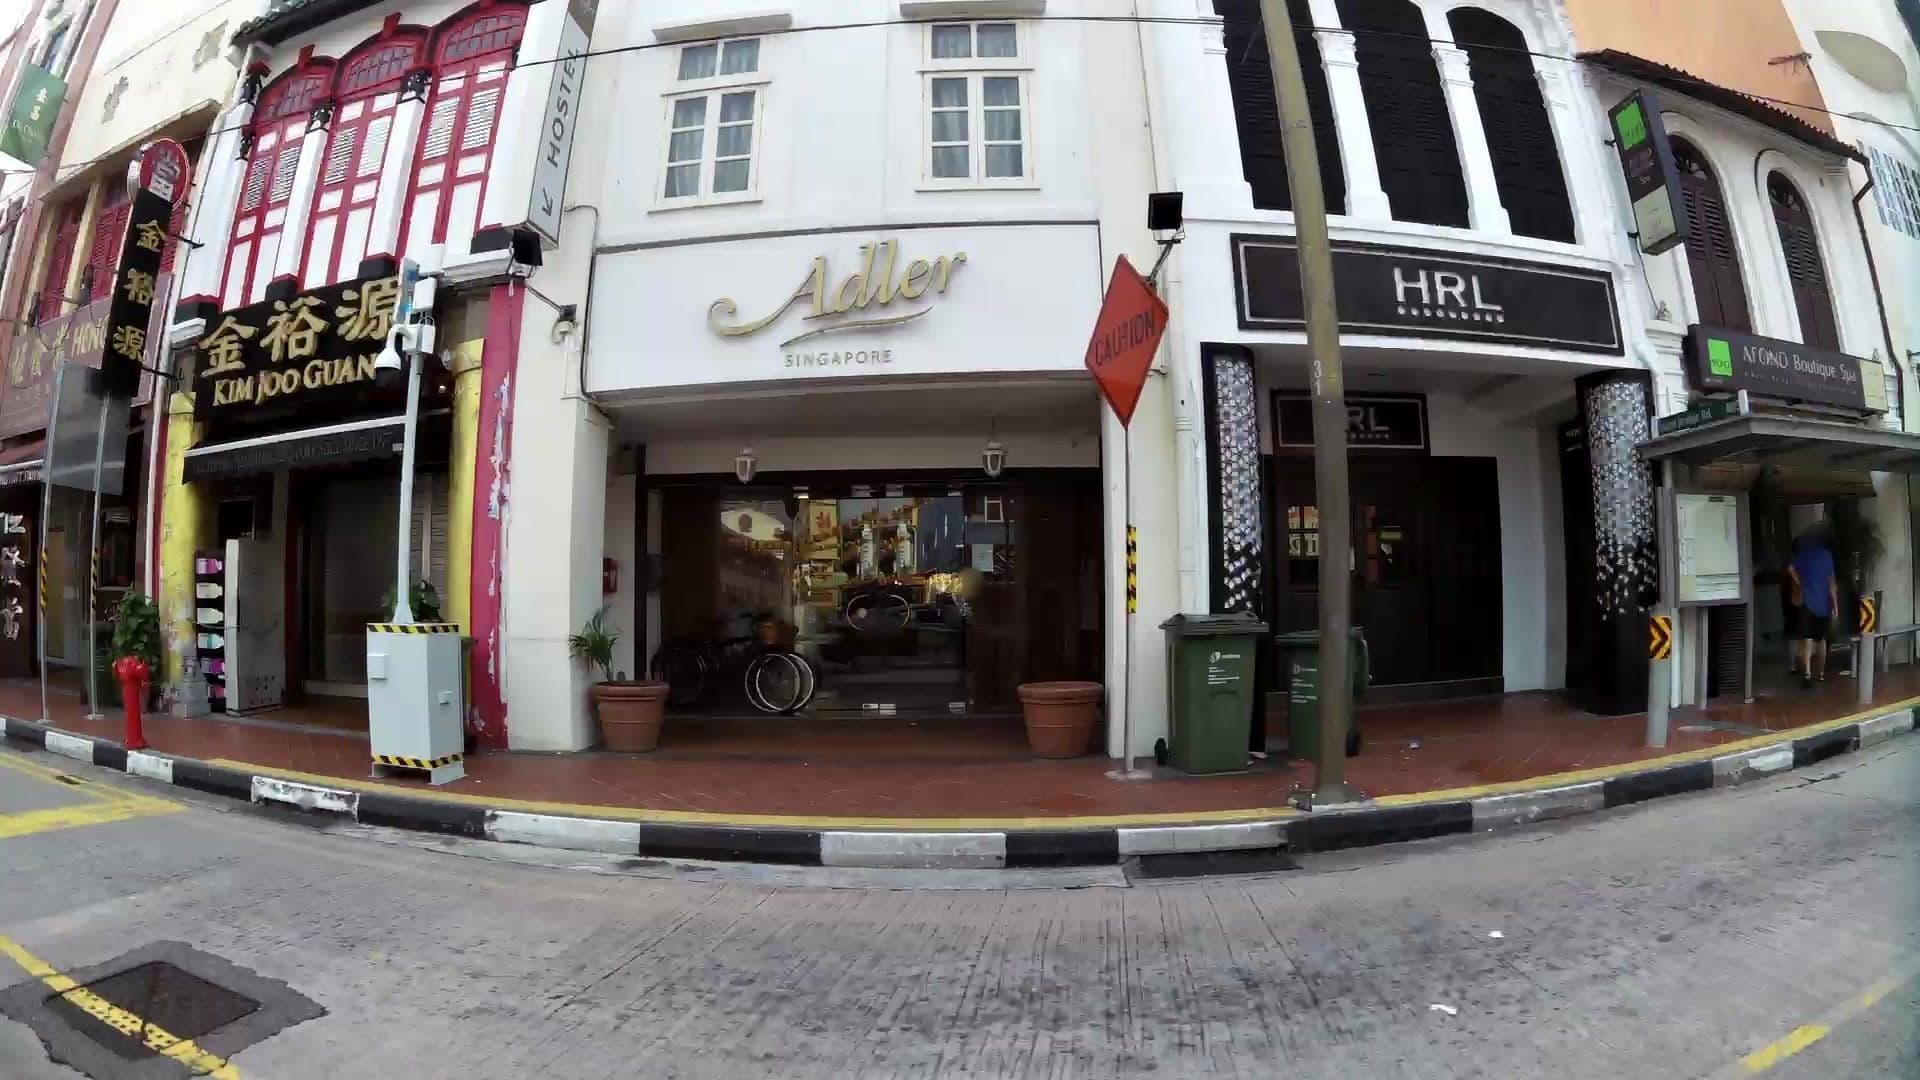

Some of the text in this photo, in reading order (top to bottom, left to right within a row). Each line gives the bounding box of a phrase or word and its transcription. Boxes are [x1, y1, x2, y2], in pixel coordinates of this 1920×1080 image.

[547, 48, 579, 168] HOSTEL
[113, 219, 166, 363] 金裕源
[708, 239, 968, 337] Adler
[1393, 267, 1503, 311] HRL
[199, 277, 398, 378] 金裕源
[1095, 308, 1156, 367] CAUTION
[212, 353, 378, 407] KIM JOO GUAN
[784, 349, 893, 368] SINGAPORE
[1793, 354, 1837, 379] Boutique
[1840, 364, 1857, 386] Spa
[1345, 406, 1390, 432] RL
